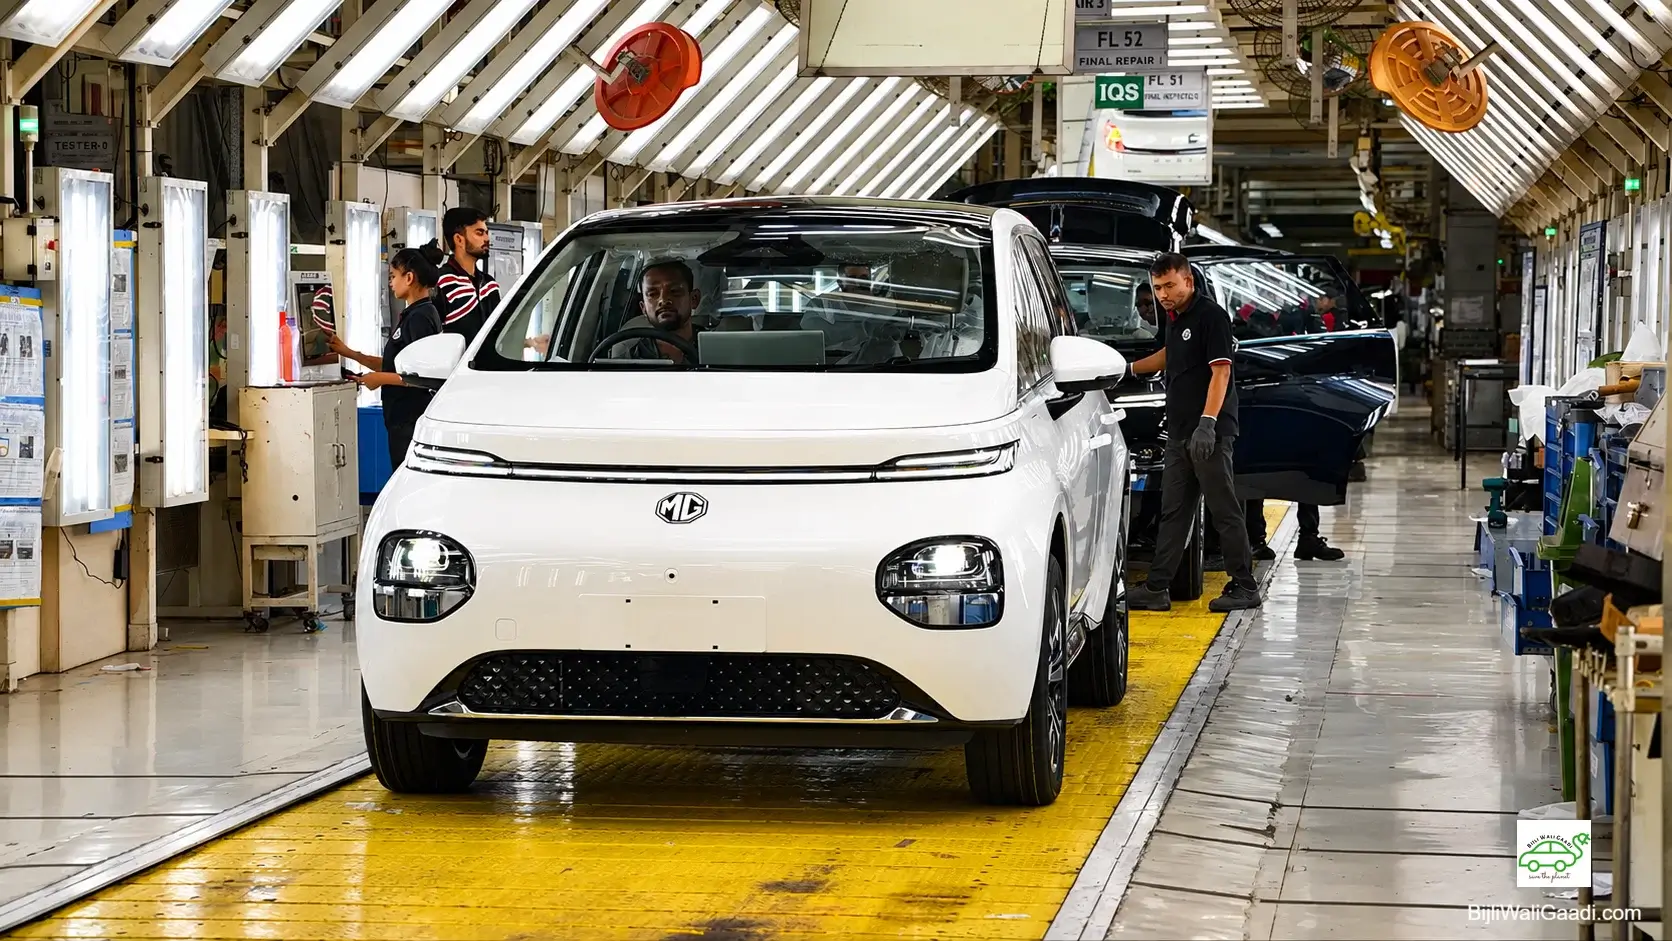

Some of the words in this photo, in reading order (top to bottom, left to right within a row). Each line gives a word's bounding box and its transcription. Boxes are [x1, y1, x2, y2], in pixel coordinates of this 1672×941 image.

[1097, 31, 1119, 48] FL
[1124, 30, 1143, 47] 52
[1079, 57, 1112, 67] FINAL
[1115, 56, 1155, 66] REPAIR
[1148, 74, 1164, 86] FL
[1169, 74, 1183, 86] 51
[1099, 83, 1140, 102] IQS
[658, 493, 706, 522] MG
